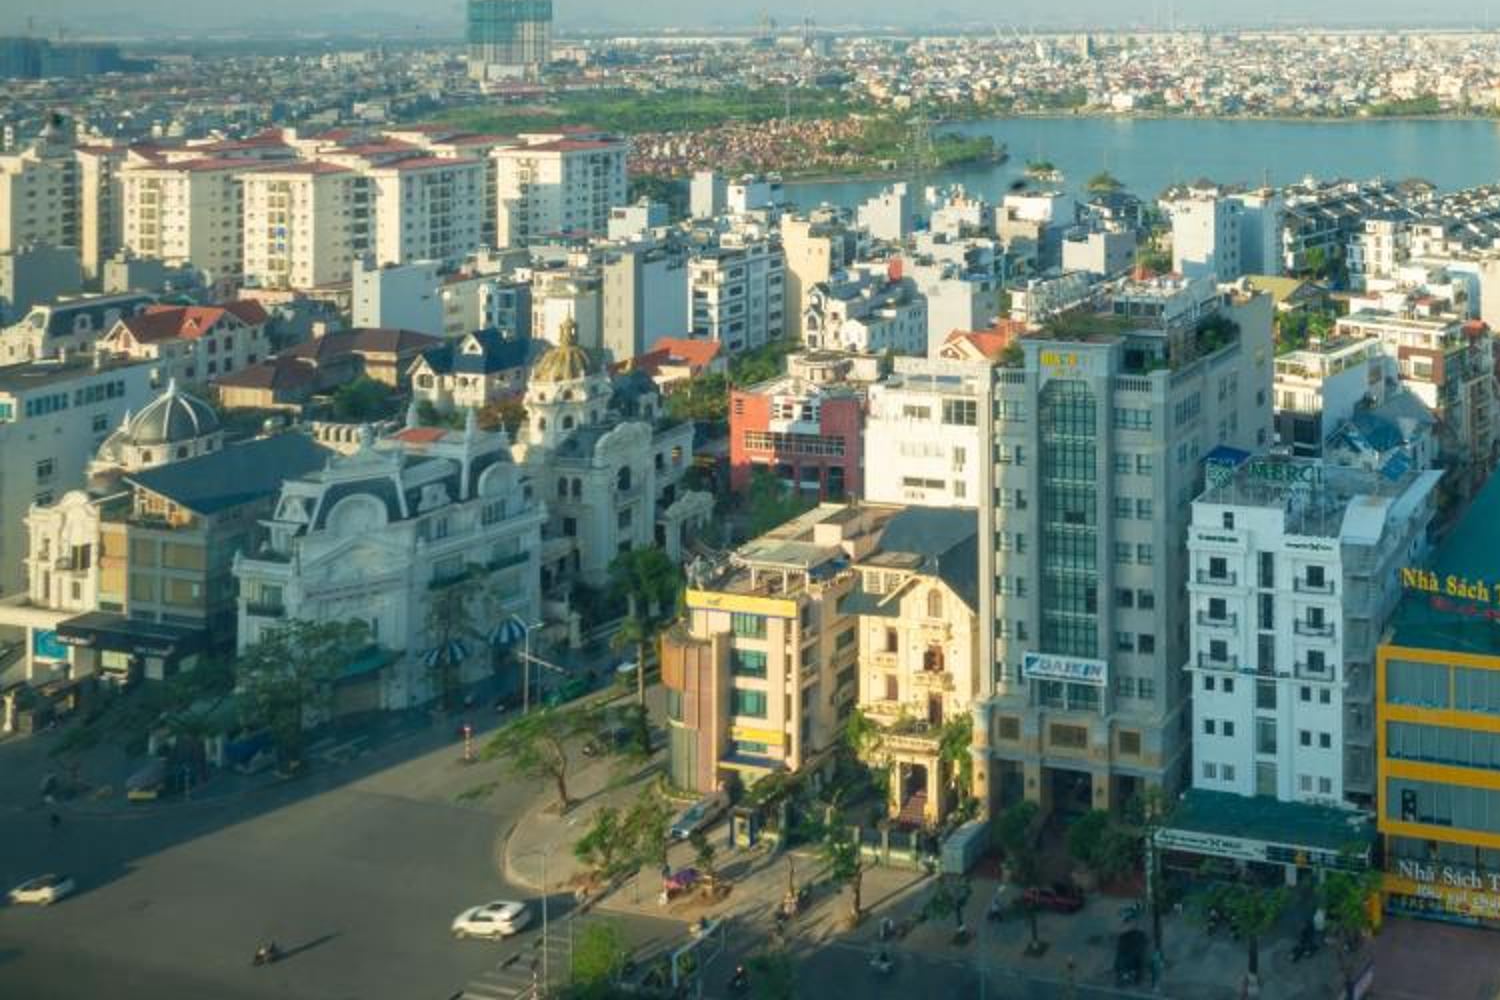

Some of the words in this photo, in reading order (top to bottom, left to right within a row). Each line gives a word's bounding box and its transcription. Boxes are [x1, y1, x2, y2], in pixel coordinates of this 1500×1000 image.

[1401, 568, 1439, 591] Nhà
[1446, 575, 1489, 602] Sách
[1442, 866, 1483, 888] Sách
